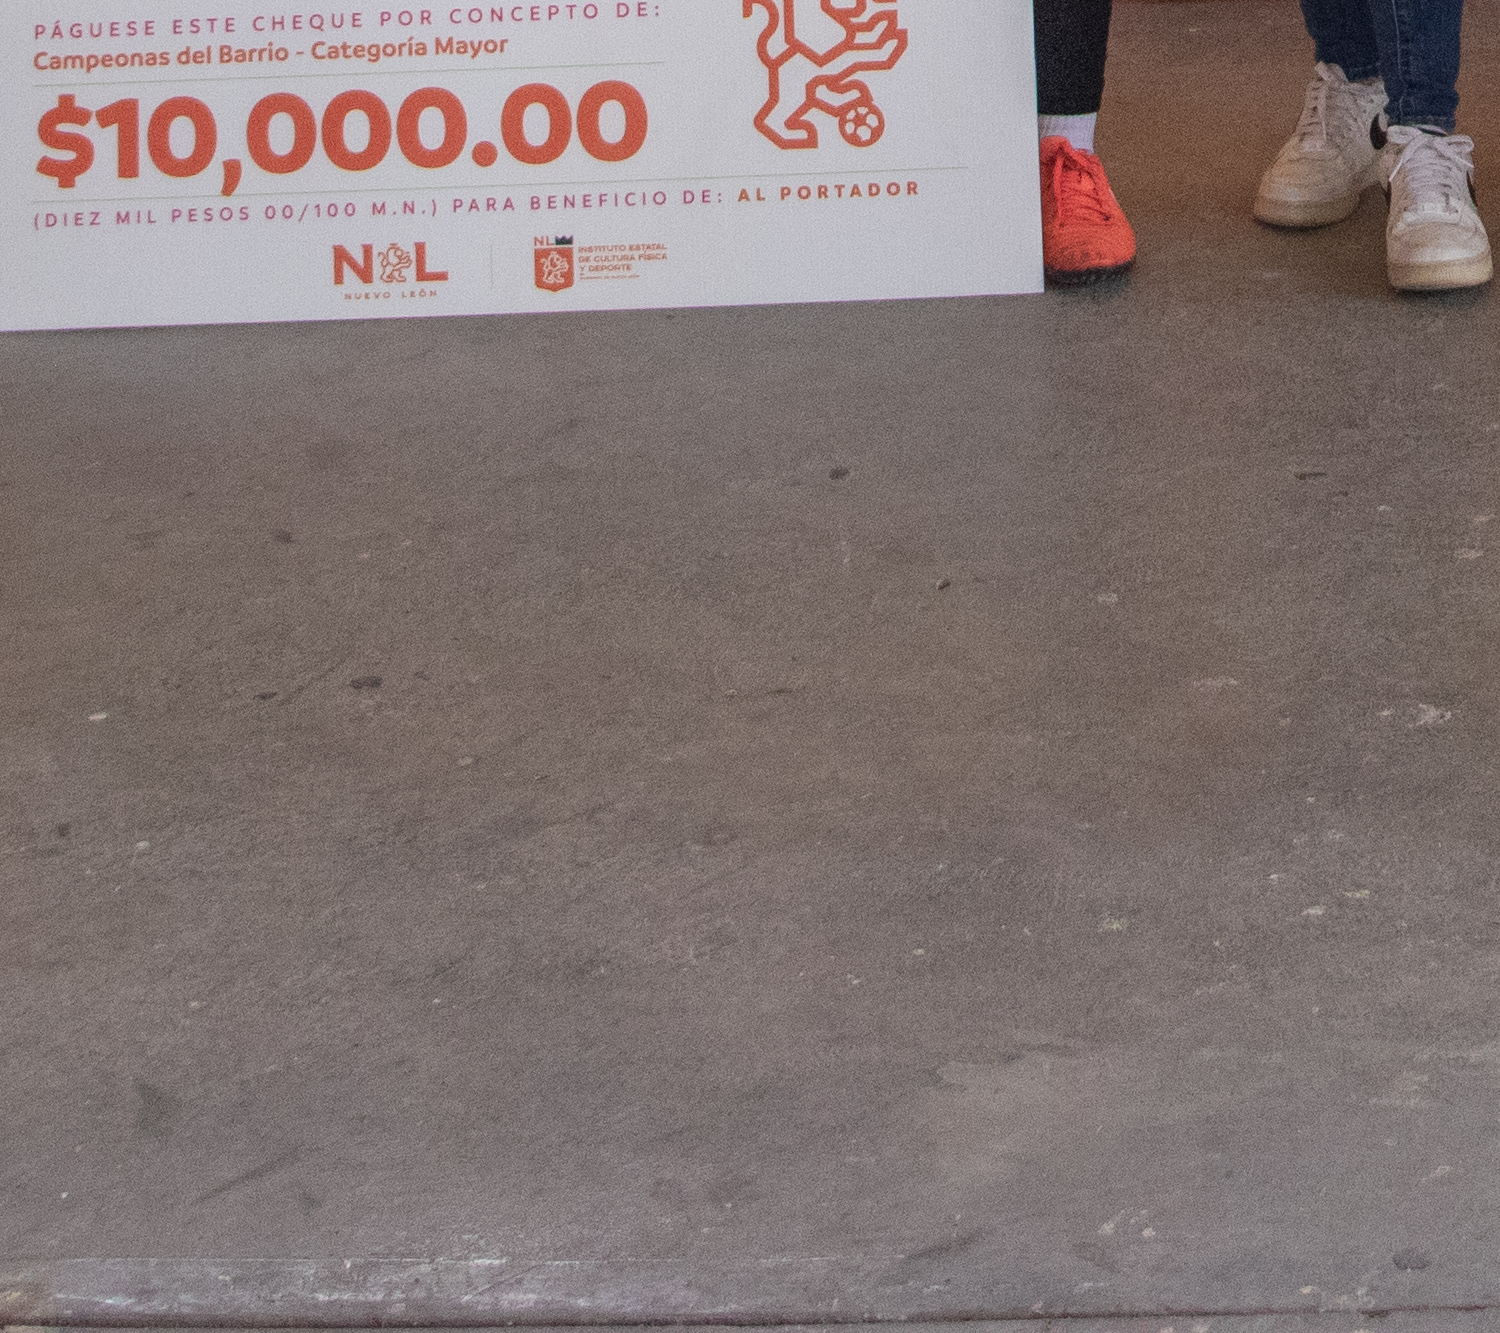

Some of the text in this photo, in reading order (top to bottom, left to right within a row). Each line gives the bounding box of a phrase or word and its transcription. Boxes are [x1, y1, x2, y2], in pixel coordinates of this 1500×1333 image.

[33, 1, 662, 42] PÁGUESE ESTE CHEQUE POR CONCEPTO DE:
[33, 35, 509, 74] Campeonas del Barrio Categoría Mayor
[35, 79, 649, 198] $10,000.00
[33, 180, 921, 232] (DIEZ MIL PESOS 00/100 M.N.) PARA BENEFICIO DE: AL PORTADOR
[577, 241, 668, 255] INSTITUTO ESTATAL
[577, 254, 591, 264] DE
[592, 252, 637, 264] CULTURA
[589, 263, 633, 273] DEPORTE
[343, 287, 439, 302] NUEVO LEÓN
